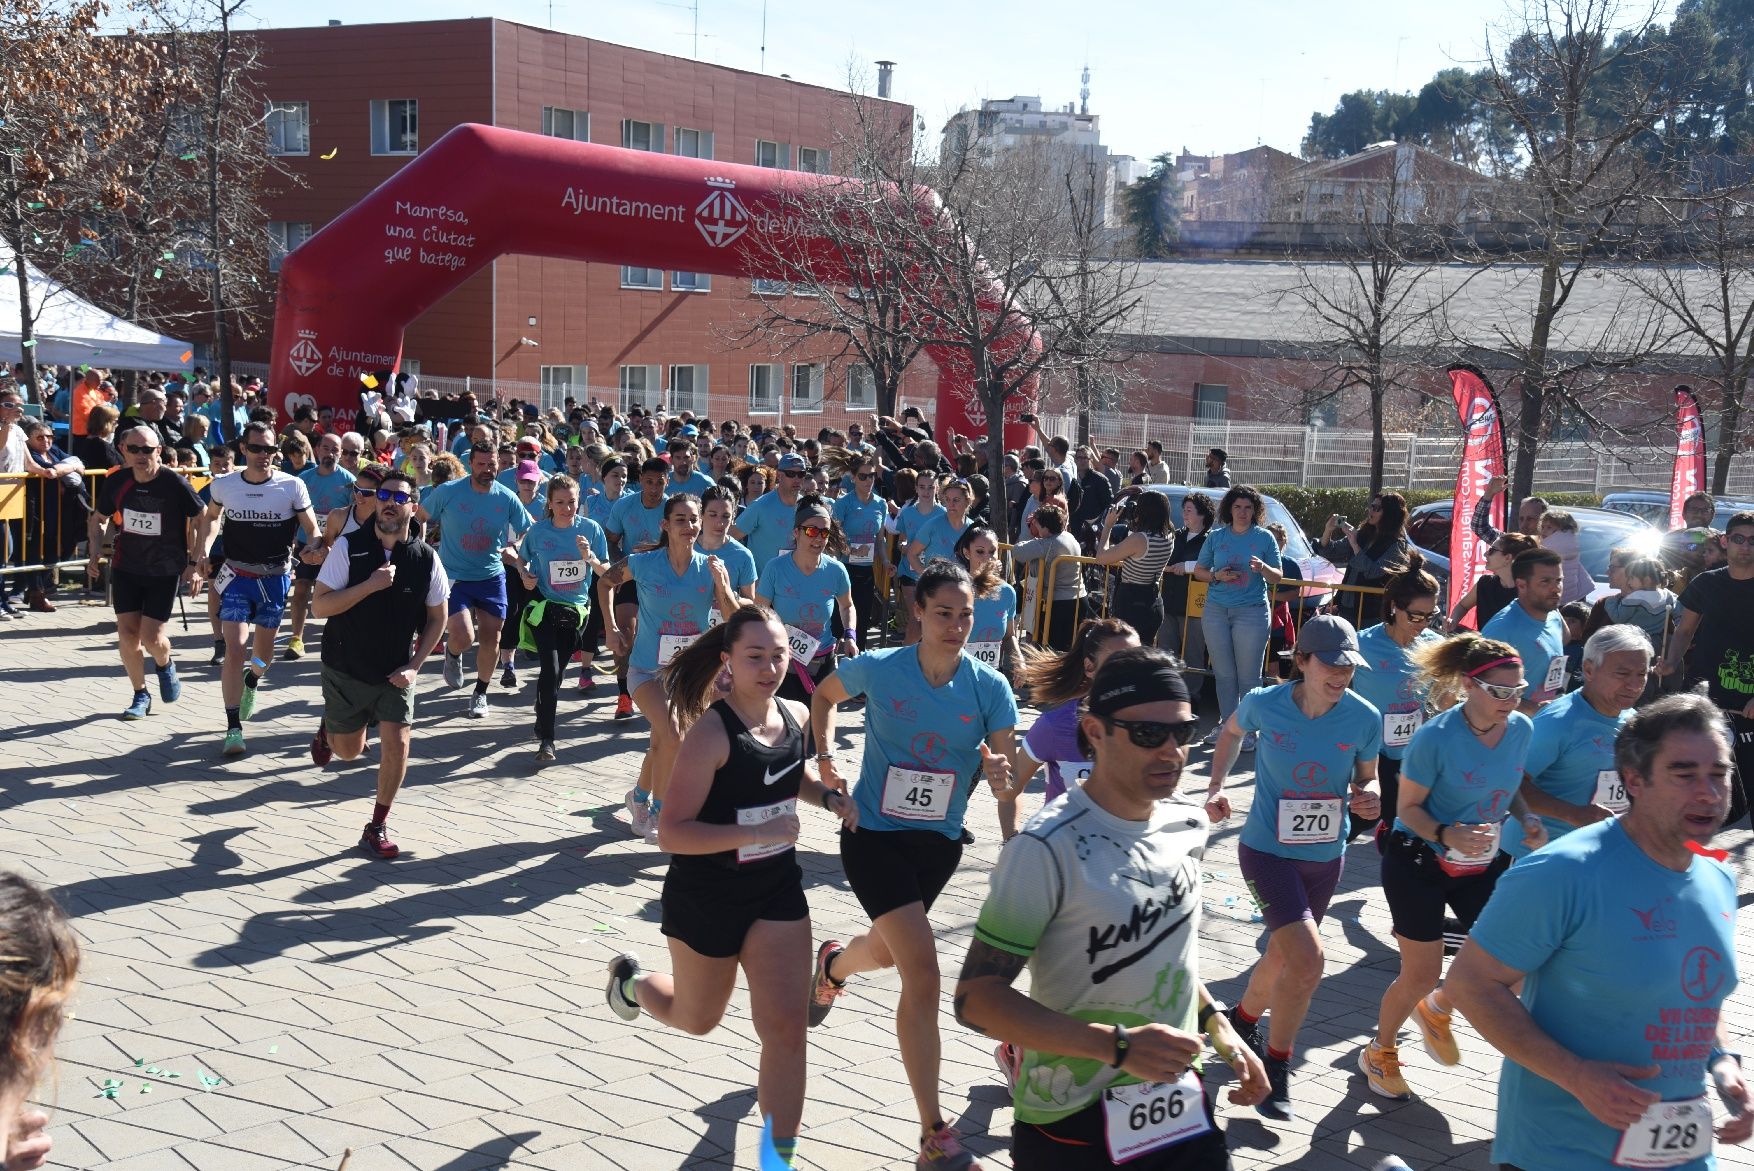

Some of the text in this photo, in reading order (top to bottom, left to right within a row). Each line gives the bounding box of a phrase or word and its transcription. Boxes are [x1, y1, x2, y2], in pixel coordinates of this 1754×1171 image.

[395, 201, 471, 226] Manresa,
[562, 187, 687, 222] Ajuntament
[385, 223, 477, 248] una ciutat
[385, 246, 467, 271] que batega
[329, 344, 397, 367] Ajuntament
[327, 363, 345, 377] de
[130, 517, 153, 530] 712
[226, 508, 282, 521] Collbaix
[557, 565, 579, 578] 730
[1393, 721, 1416, 737] 441
[905, 786, 934, 807] 45
[1608, 784, 1628, 801] 18
[1291, 814, 1330, 832] 270
[1645, 1025, 1672, 1043] DE
[1128, 1089, 1185, 1131] 666
[1647, 1122, 1699, 1150] 128
